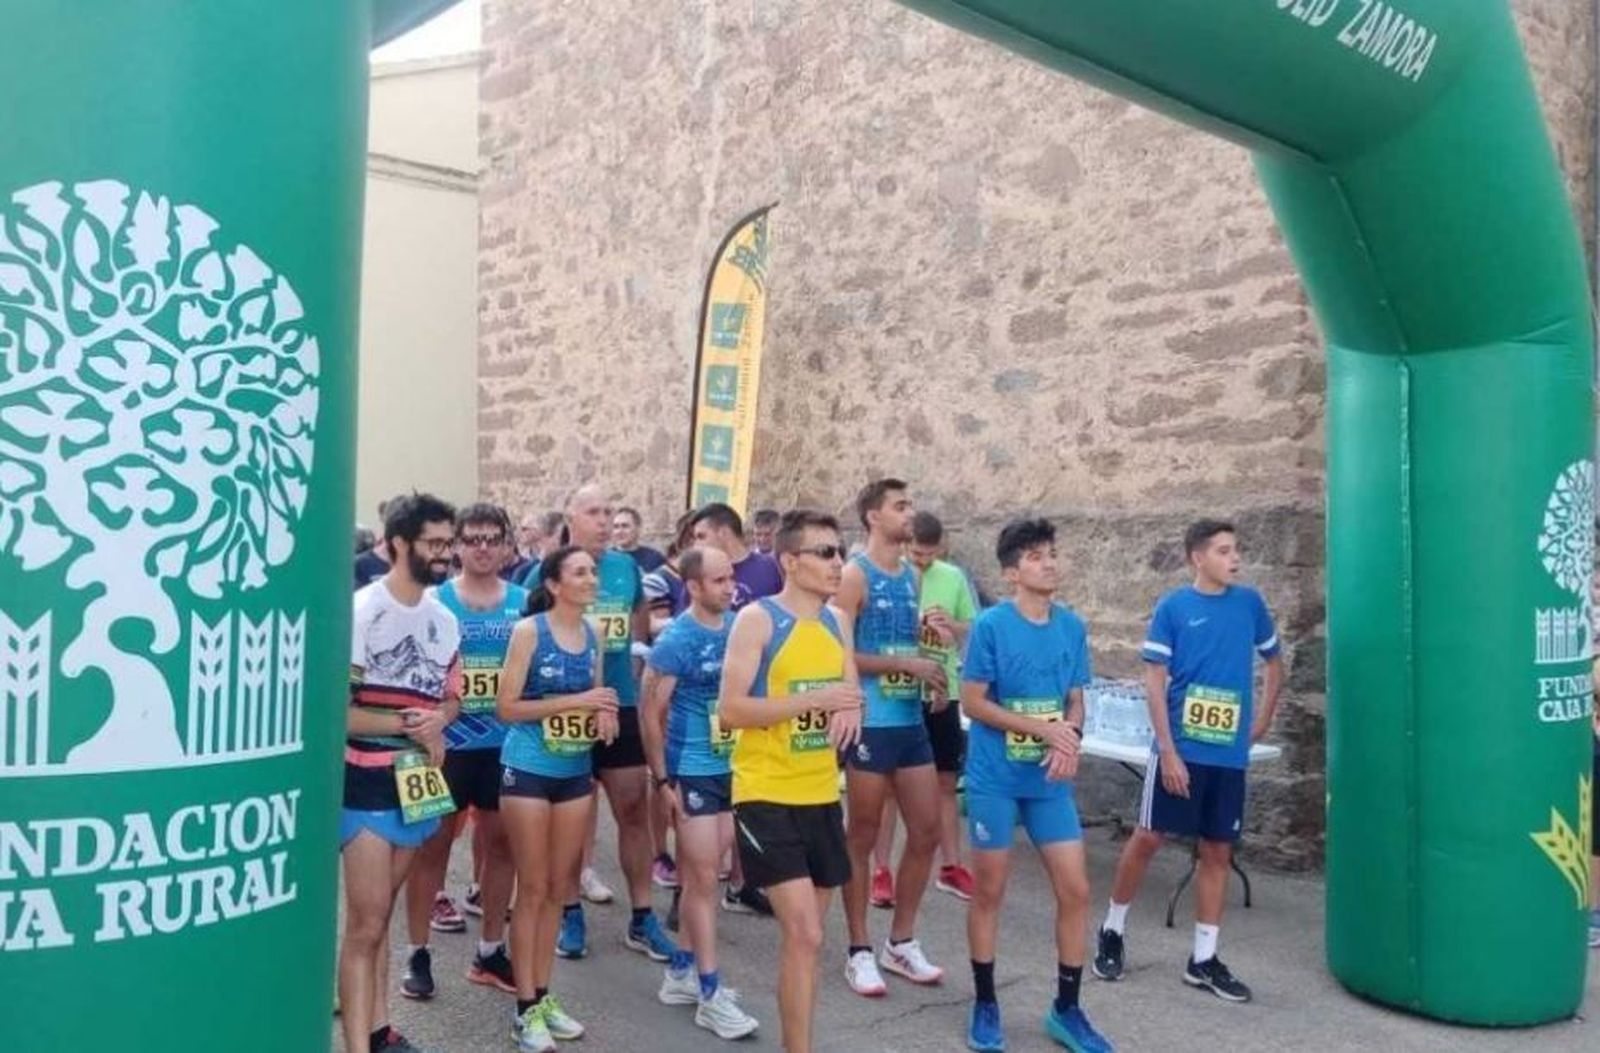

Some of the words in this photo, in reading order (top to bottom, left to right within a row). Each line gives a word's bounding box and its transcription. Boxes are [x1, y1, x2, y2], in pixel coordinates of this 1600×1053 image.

[1336, 0, 1438, 83] ZAMORA
[1189, 702, 1234, 730] 963
[94, 851, 297, 942] RURAL
